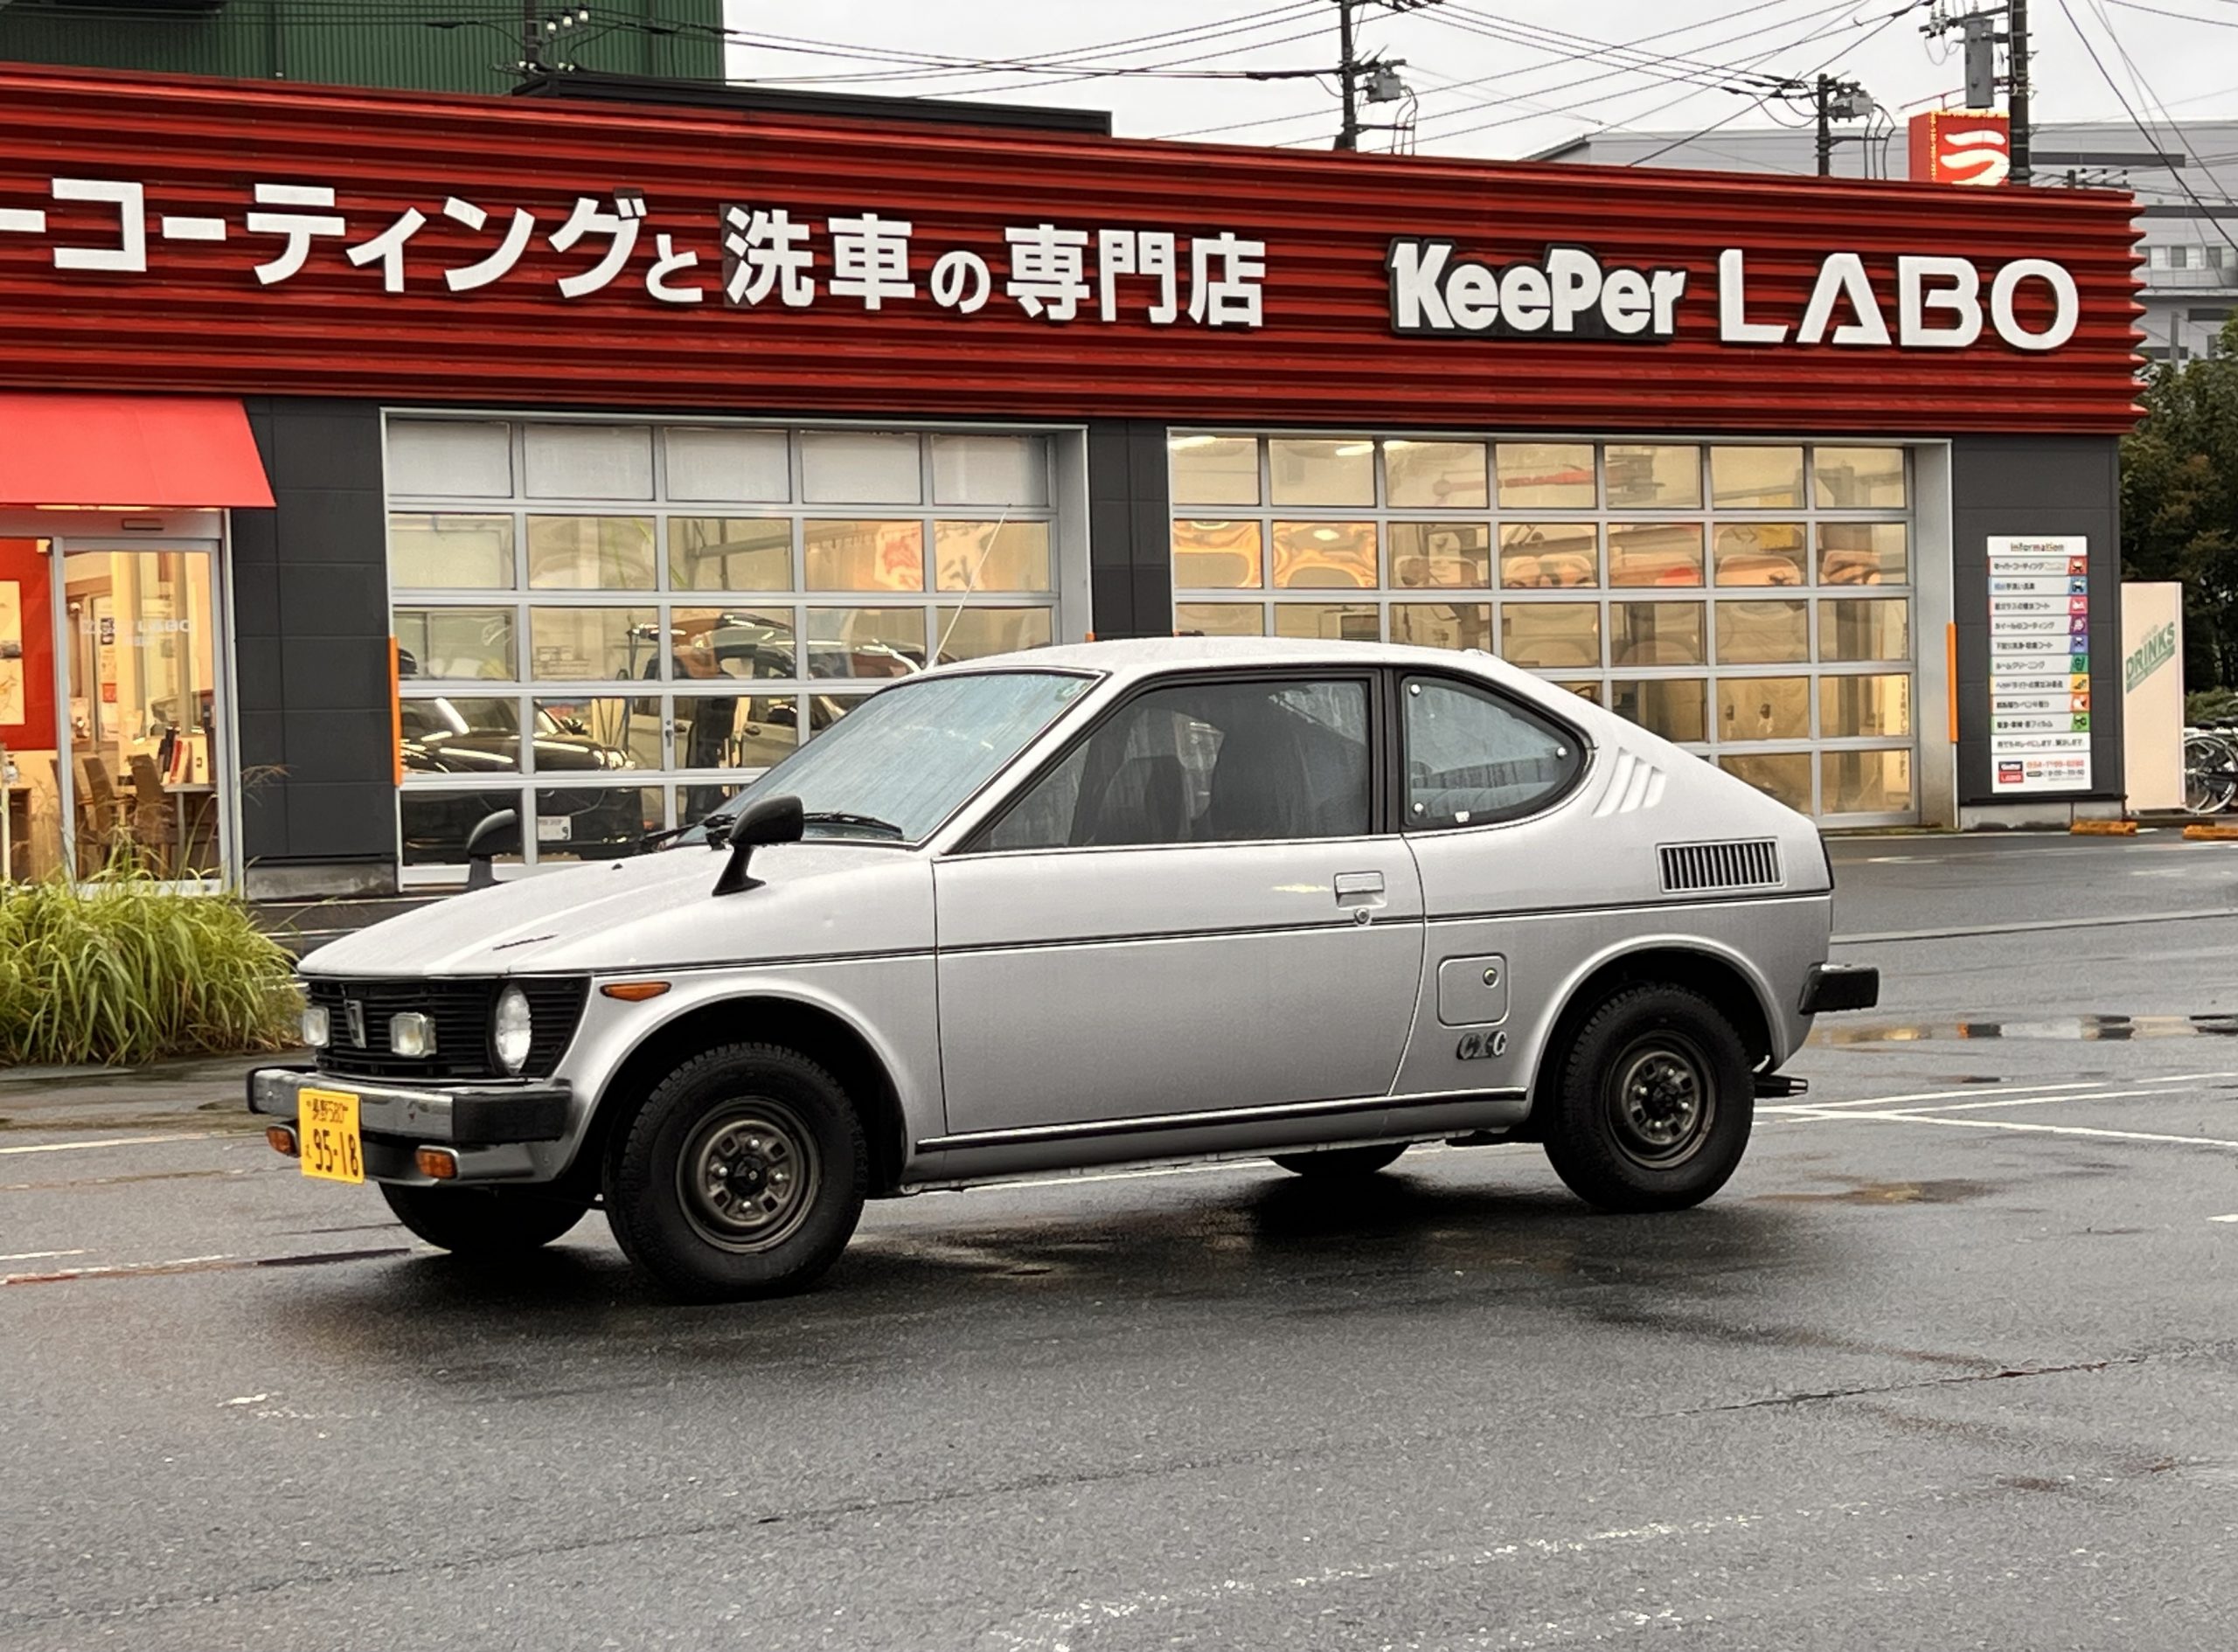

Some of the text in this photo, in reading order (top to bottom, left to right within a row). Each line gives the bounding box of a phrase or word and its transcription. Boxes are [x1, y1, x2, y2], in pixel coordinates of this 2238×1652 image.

[1392, 243, 2079, 350] KeePer LABO
[2126, 621, 2175, 681] DRINKS
